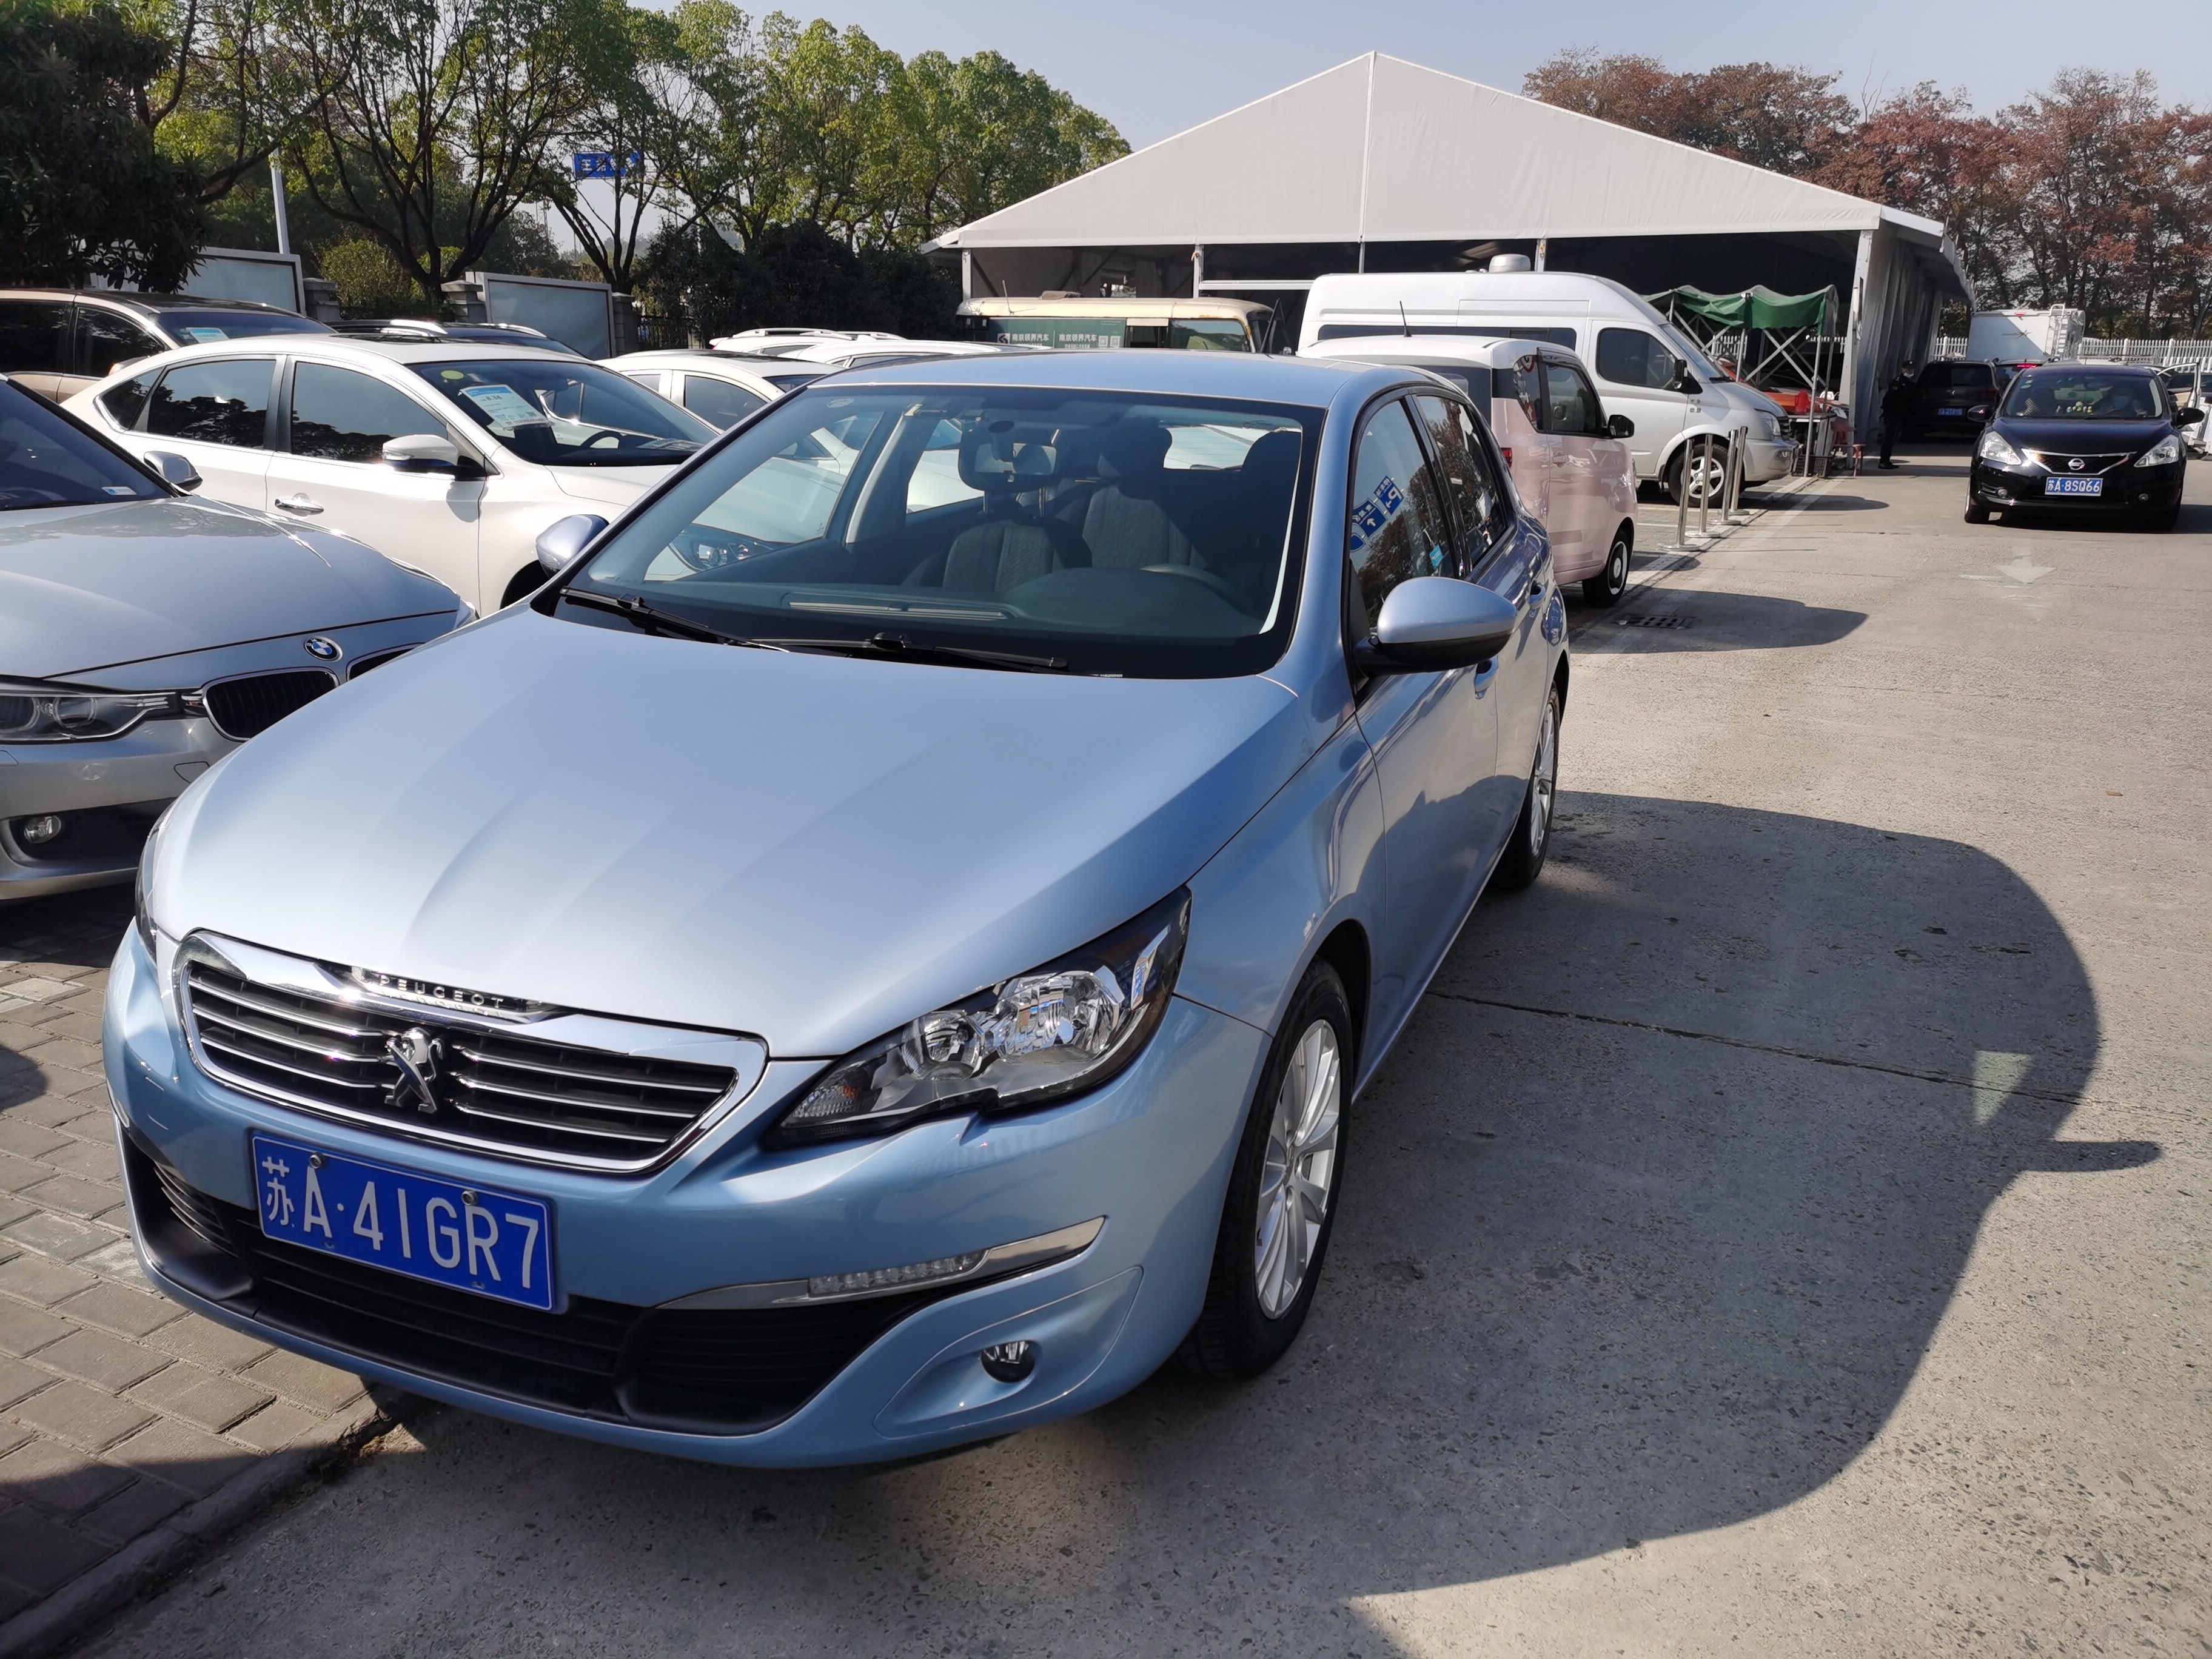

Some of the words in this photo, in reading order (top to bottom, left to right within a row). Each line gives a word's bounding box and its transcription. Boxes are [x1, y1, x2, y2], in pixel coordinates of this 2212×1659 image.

[2048, 479, 2100, 492] 苏A·8SQ66
[379, 974, 504, 1008] PEUGEOT
[263, 1156, 539, 1289] 苏A·41GR7
